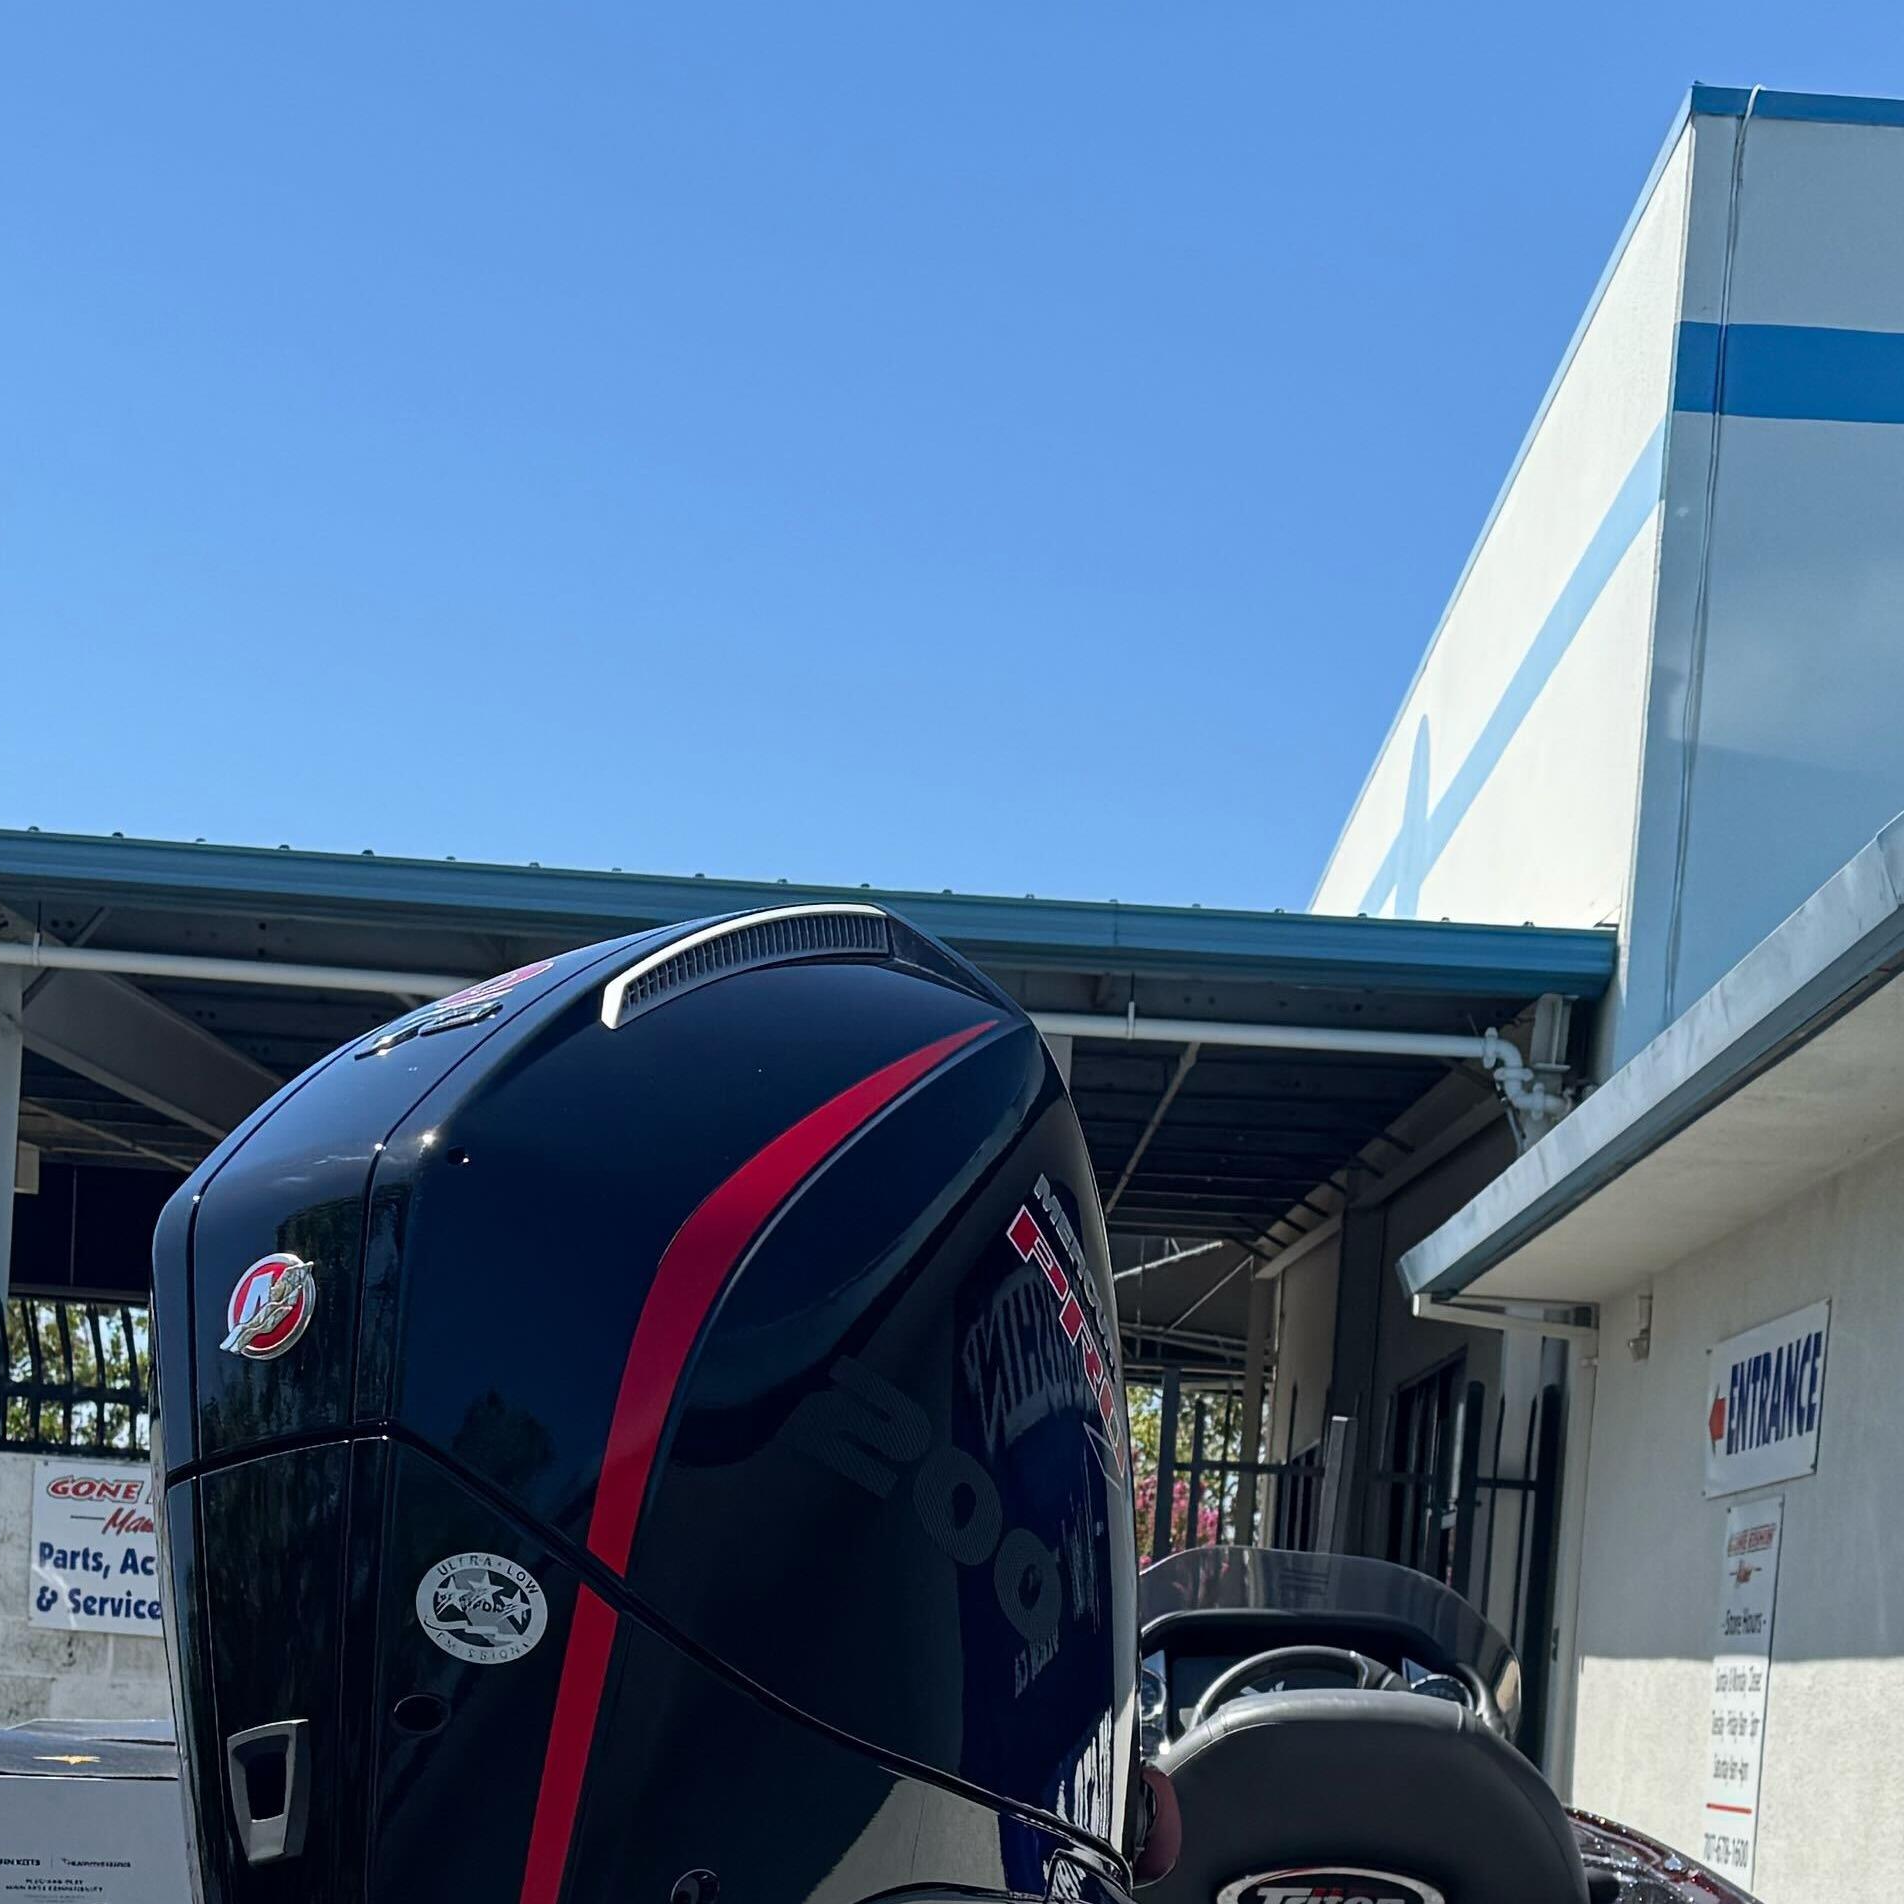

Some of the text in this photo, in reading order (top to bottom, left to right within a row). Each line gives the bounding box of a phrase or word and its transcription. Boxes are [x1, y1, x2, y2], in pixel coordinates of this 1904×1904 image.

[1727, 1331, 1823, 1455] ENTRANCE
[47, 1476, 144, 1503] GONE
[39, 1541, 110, 1579] Parts,
[436, 1554, 540, 1595] ULTRA LOW
[36, 1585, 161, 1620] & Service
